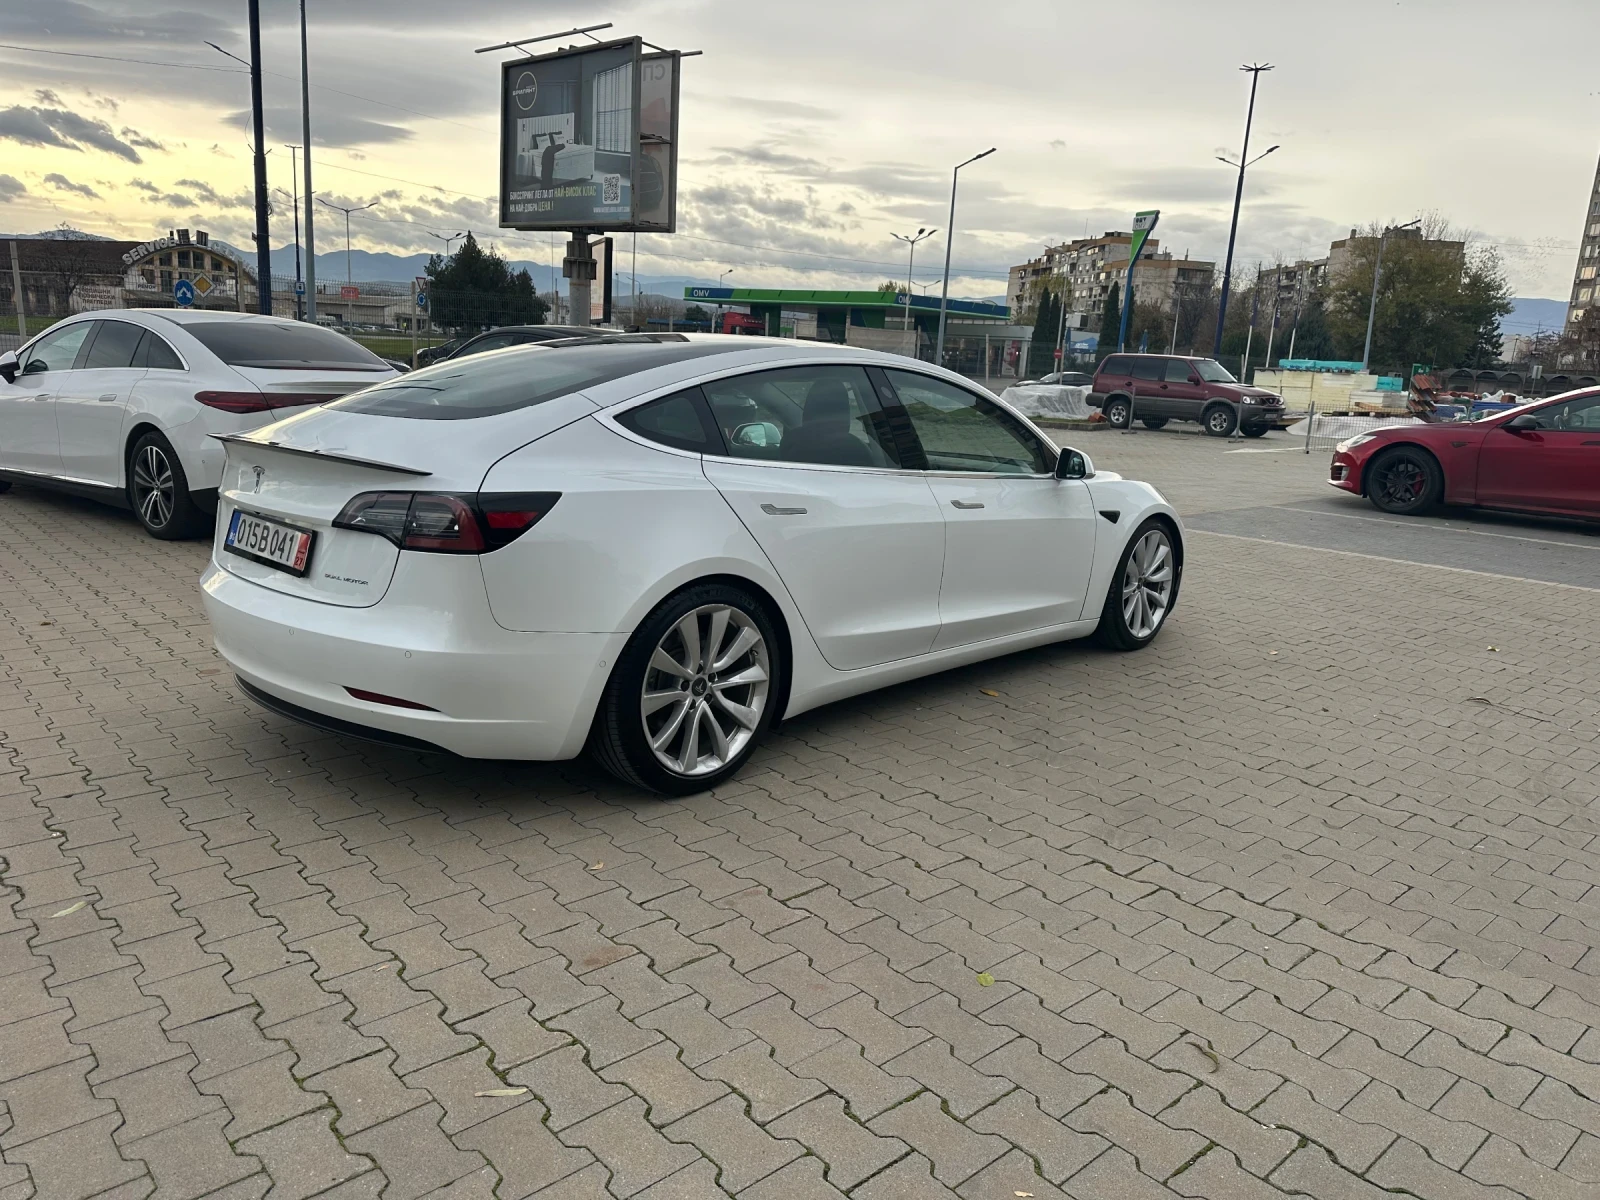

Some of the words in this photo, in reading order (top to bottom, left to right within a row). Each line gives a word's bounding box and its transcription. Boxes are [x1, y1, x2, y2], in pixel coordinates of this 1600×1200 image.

[554, 186, 582, 198] НАЙ-ВИСОК
[582, 185, 596, 196] КЛАС
[509, 203, 515, 212] НА
[538, 201, 551, 212] ЦЕНА
[121, 236, 177, 265] SERVICE
[693, 289, 710, 297] OMV
[898, 295, 913, 304] OMV
[237, 518, 295, 562] 015B041
[295, 556, 304, 567] 27
[324, 573, 342, 581] DUAL
[343, 577, 369, 586] MOTOR
